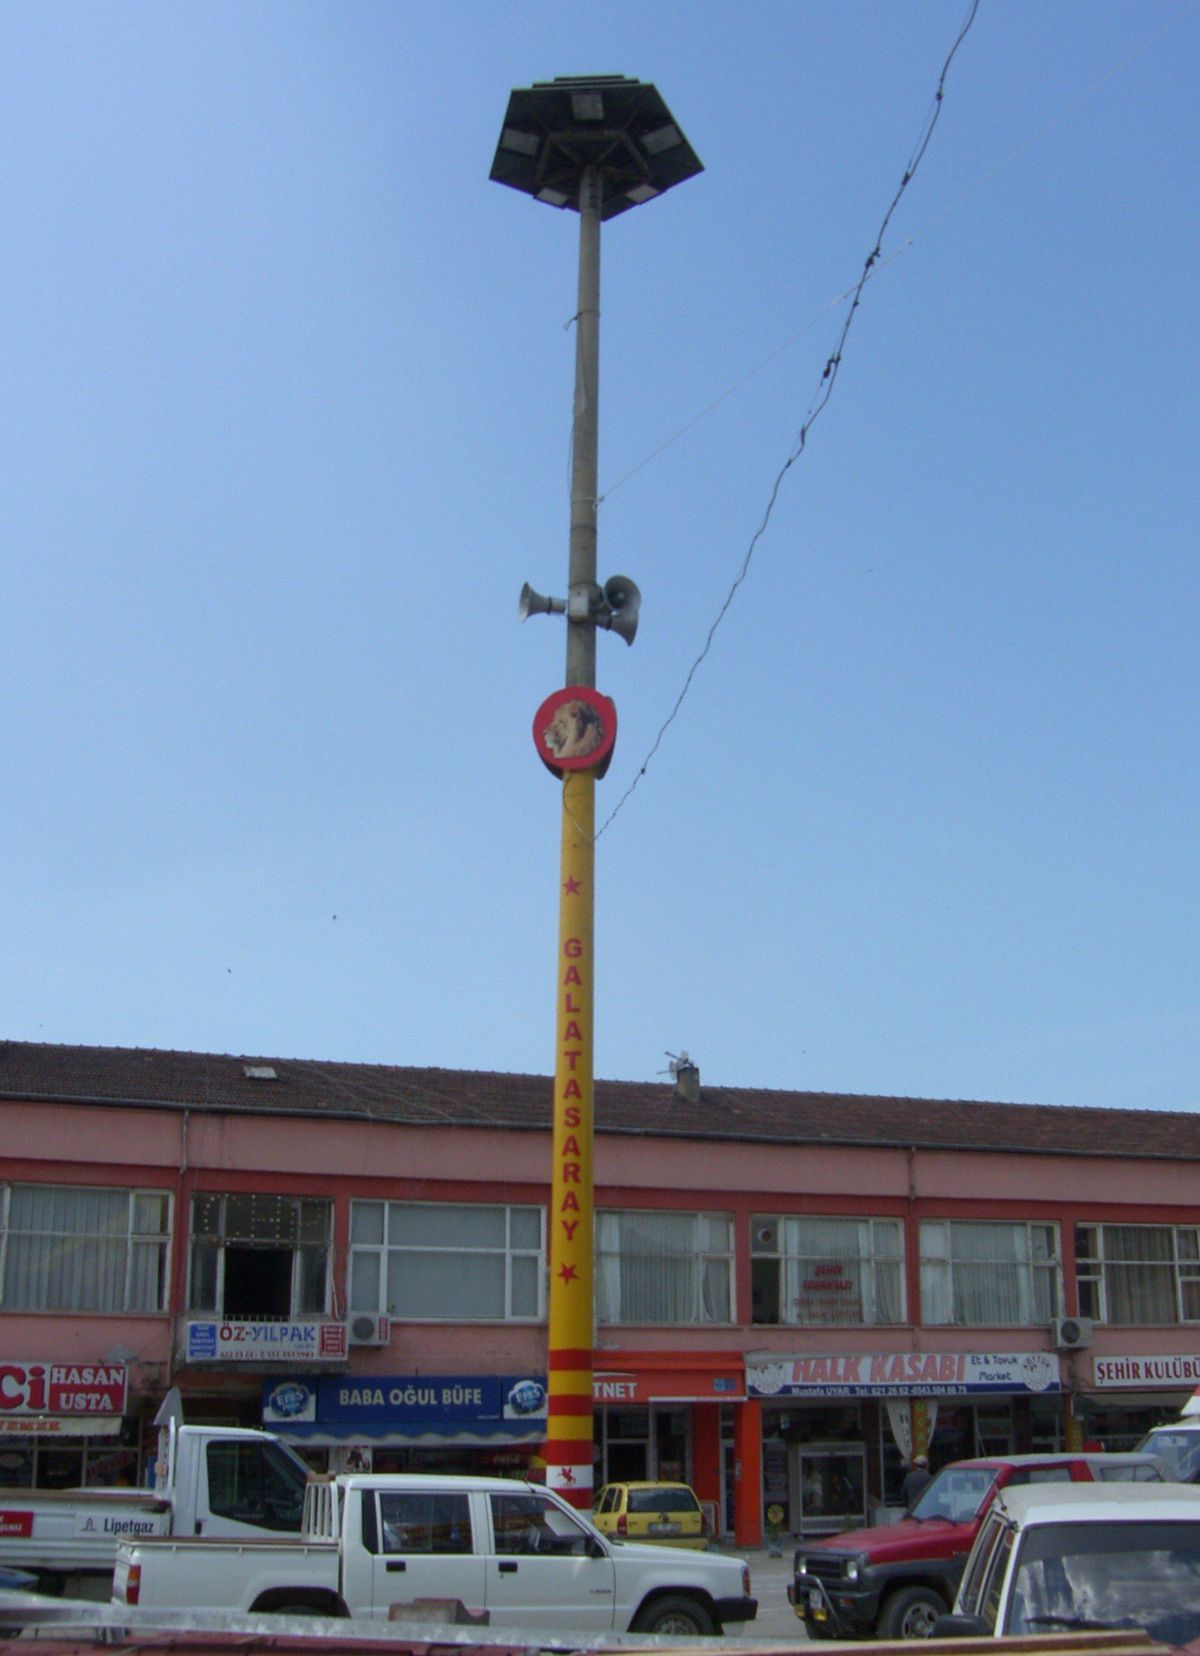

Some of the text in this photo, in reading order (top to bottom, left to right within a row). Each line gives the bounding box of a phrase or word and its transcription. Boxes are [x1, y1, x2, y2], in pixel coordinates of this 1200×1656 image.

[561, 938, 583, 1241] GALATASARAY
[219, 1322, 316, 1342] ÖZ-YILPAK
[51, 1367, 125, 1385] HASAN
[792, 1354, 966, 1382] HALK KASABI
[979, 1371, 1012, 1381] Market
[1097, 1357, 1200, 1384] ŞEHİR KULÜBÜ
[339, 1384, 482, 1405] BABA OĞUL BÜFE
[593, 1382, 638, 1398] TNET
[60, 1392, 113, 1410] USTA
[103, 1518, 154, 1534] Lipetgaz
